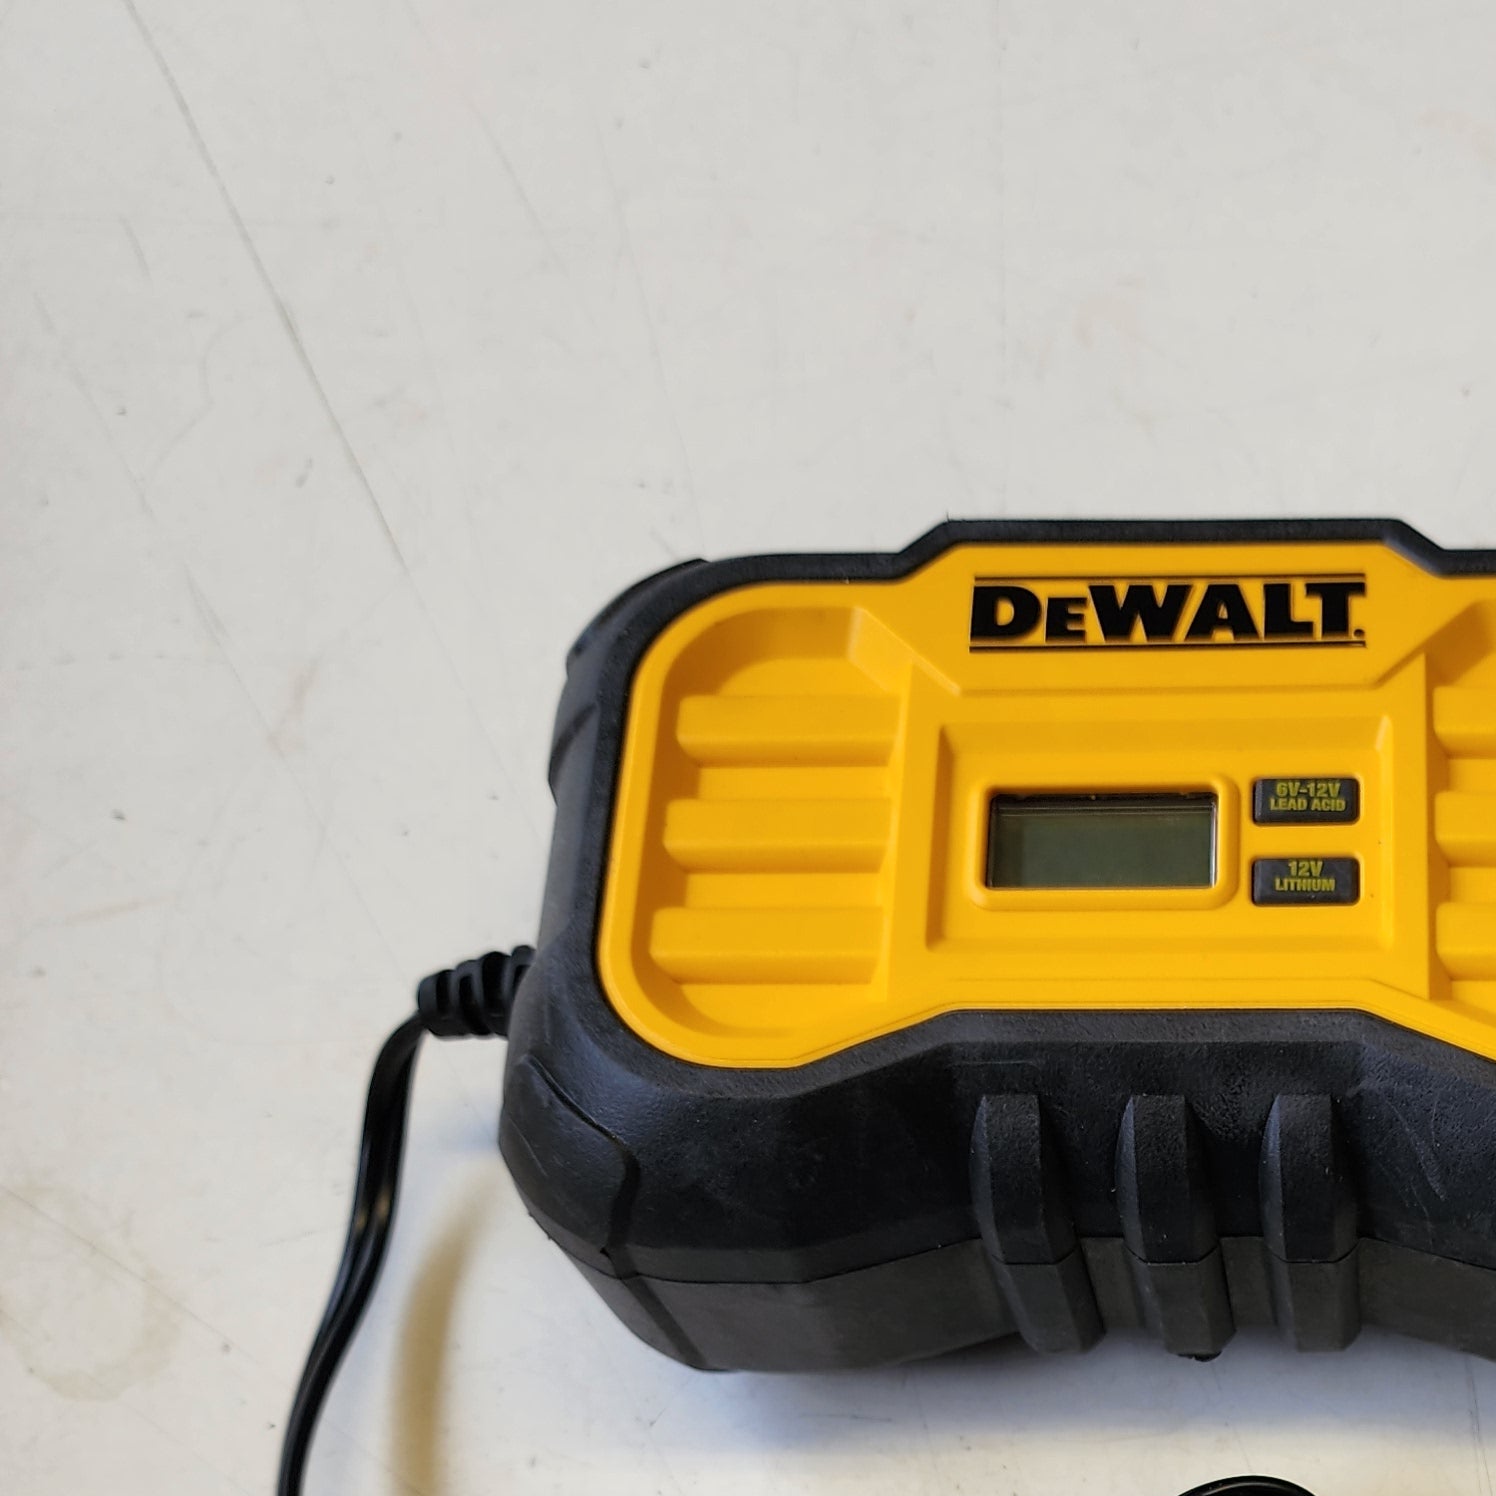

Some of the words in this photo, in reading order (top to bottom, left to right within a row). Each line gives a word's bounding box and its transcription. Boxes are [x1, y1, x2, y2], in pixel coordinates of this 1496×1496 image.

[1275, 781, 1341, 798] 6V-12V
[1270, 798, 1307, 811] LEAD
[1311, 798, 1346, 811] ACID
[1288, 860, 1323, 877] 12V
[1275, 877, 1335, 891] LITHIUM
